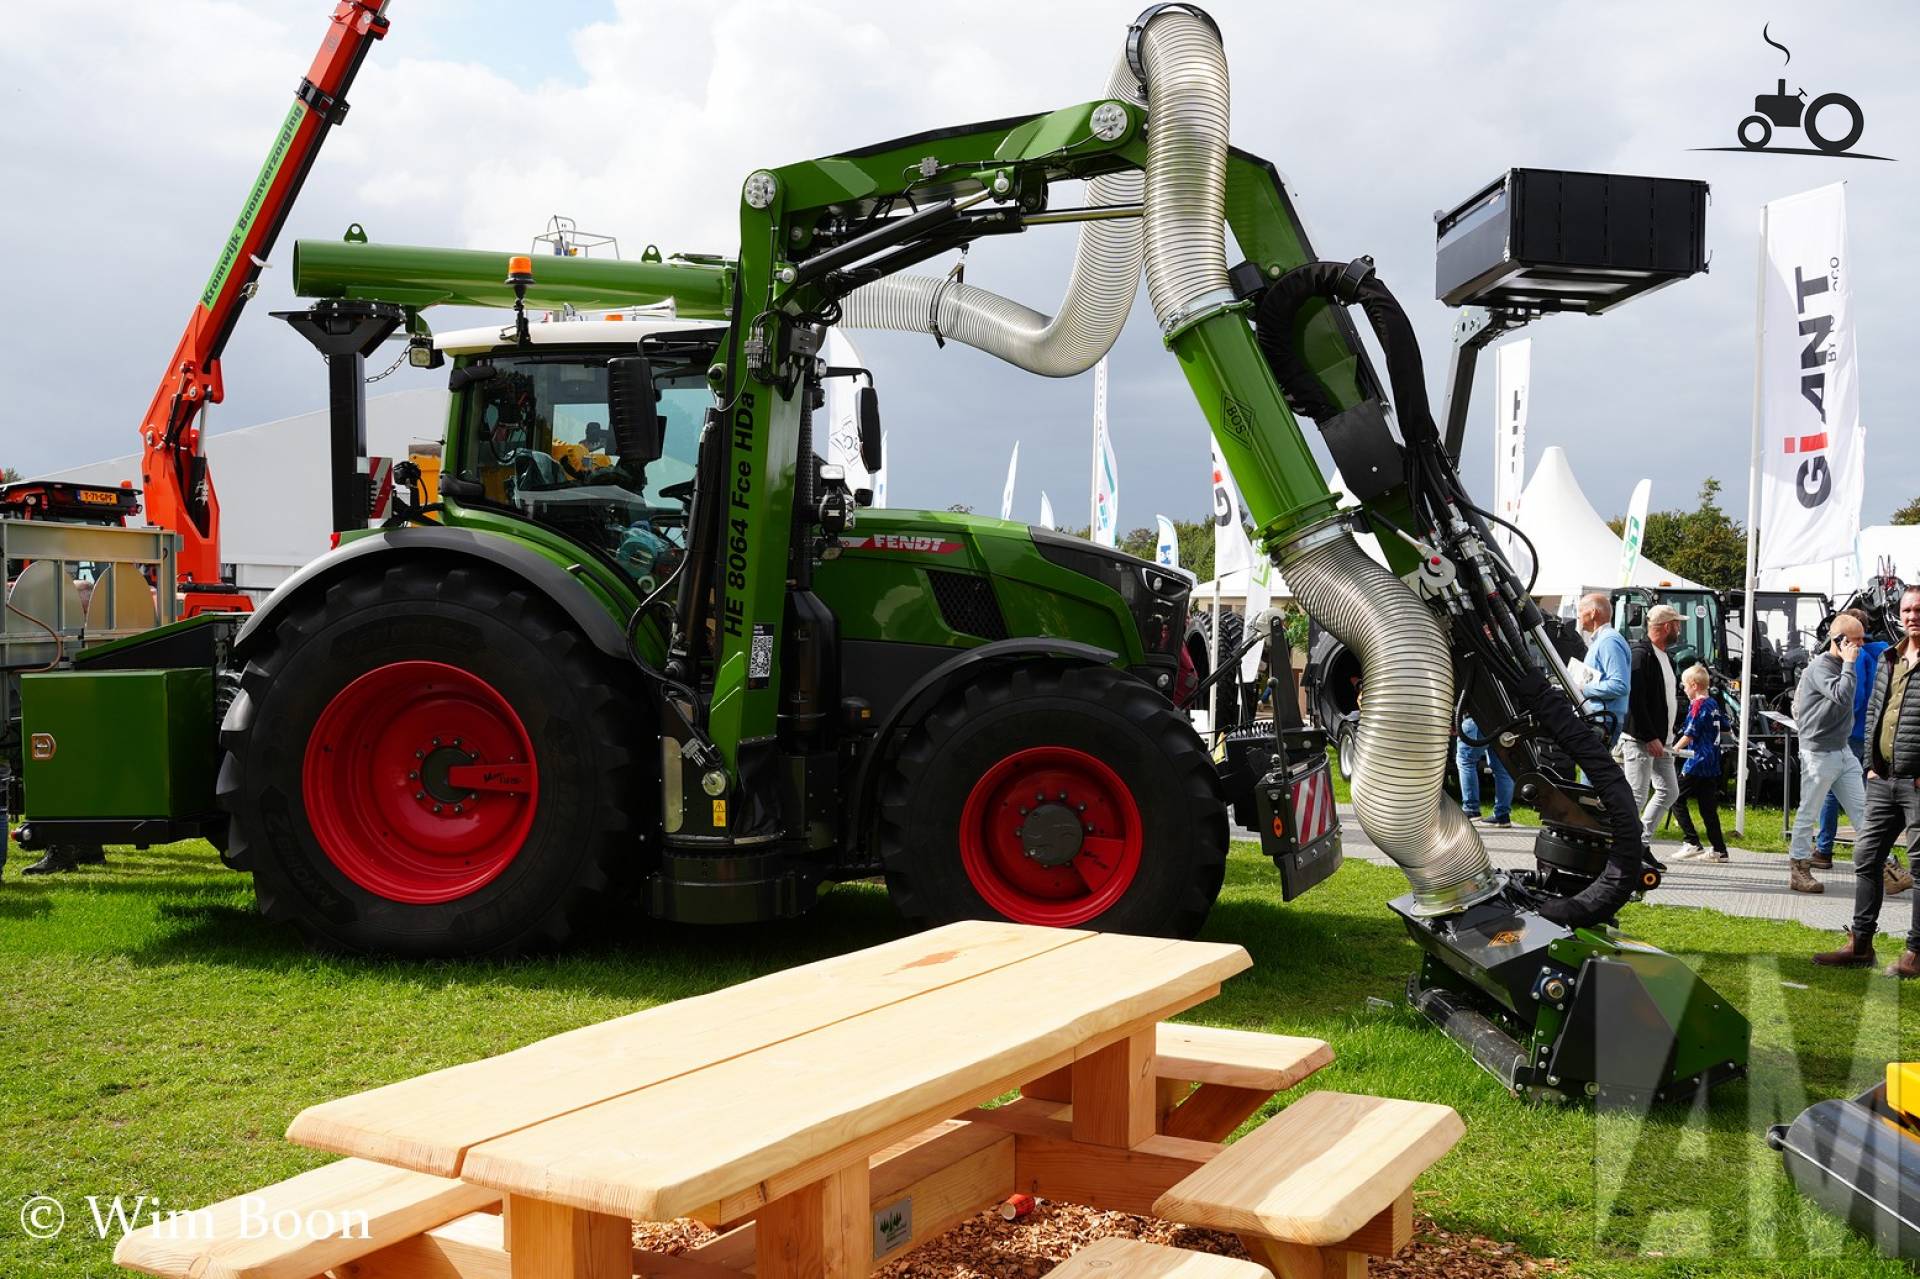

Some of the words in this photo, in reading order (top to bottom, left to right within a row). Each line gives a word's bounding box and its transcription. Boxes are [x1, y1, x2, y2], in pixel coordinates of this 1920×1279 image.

[203, 231, 241, 306] Kromwijk
[238, 106, 304, 231] Boomverzorging
[1827, 343, 1837, 362] BY
[735, 392, 755, 451] HDa
[732, 460, 752, 510] Fce
[728, 519, 748, 591] 8064
[873, 534, 946, 552] FENDT
[725, 597, 744, 638] HE
